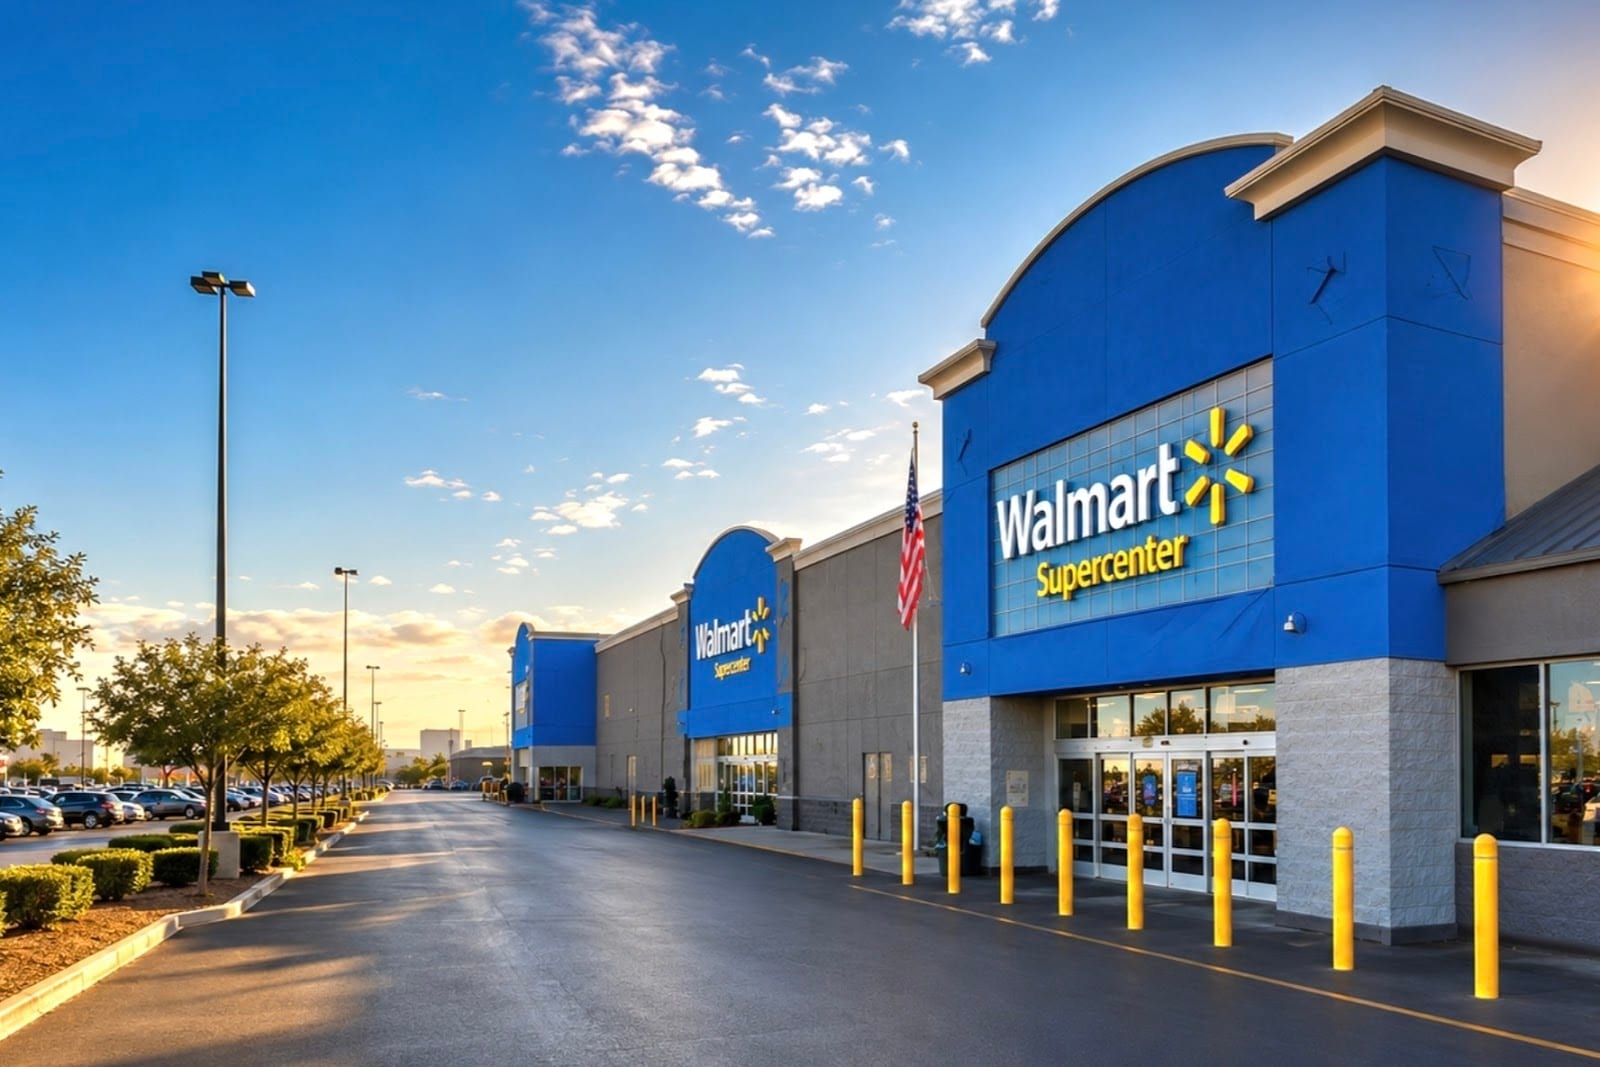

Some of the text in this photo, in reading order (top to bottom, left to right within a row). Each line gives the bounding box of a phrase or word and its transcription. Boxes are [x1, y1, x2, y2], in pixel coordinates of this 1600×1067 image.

[996, 443, 1180, 559] Walmart
[1037, 535, 1188, 600] Supercenter
[695, 609, 752, 660] Walmart
